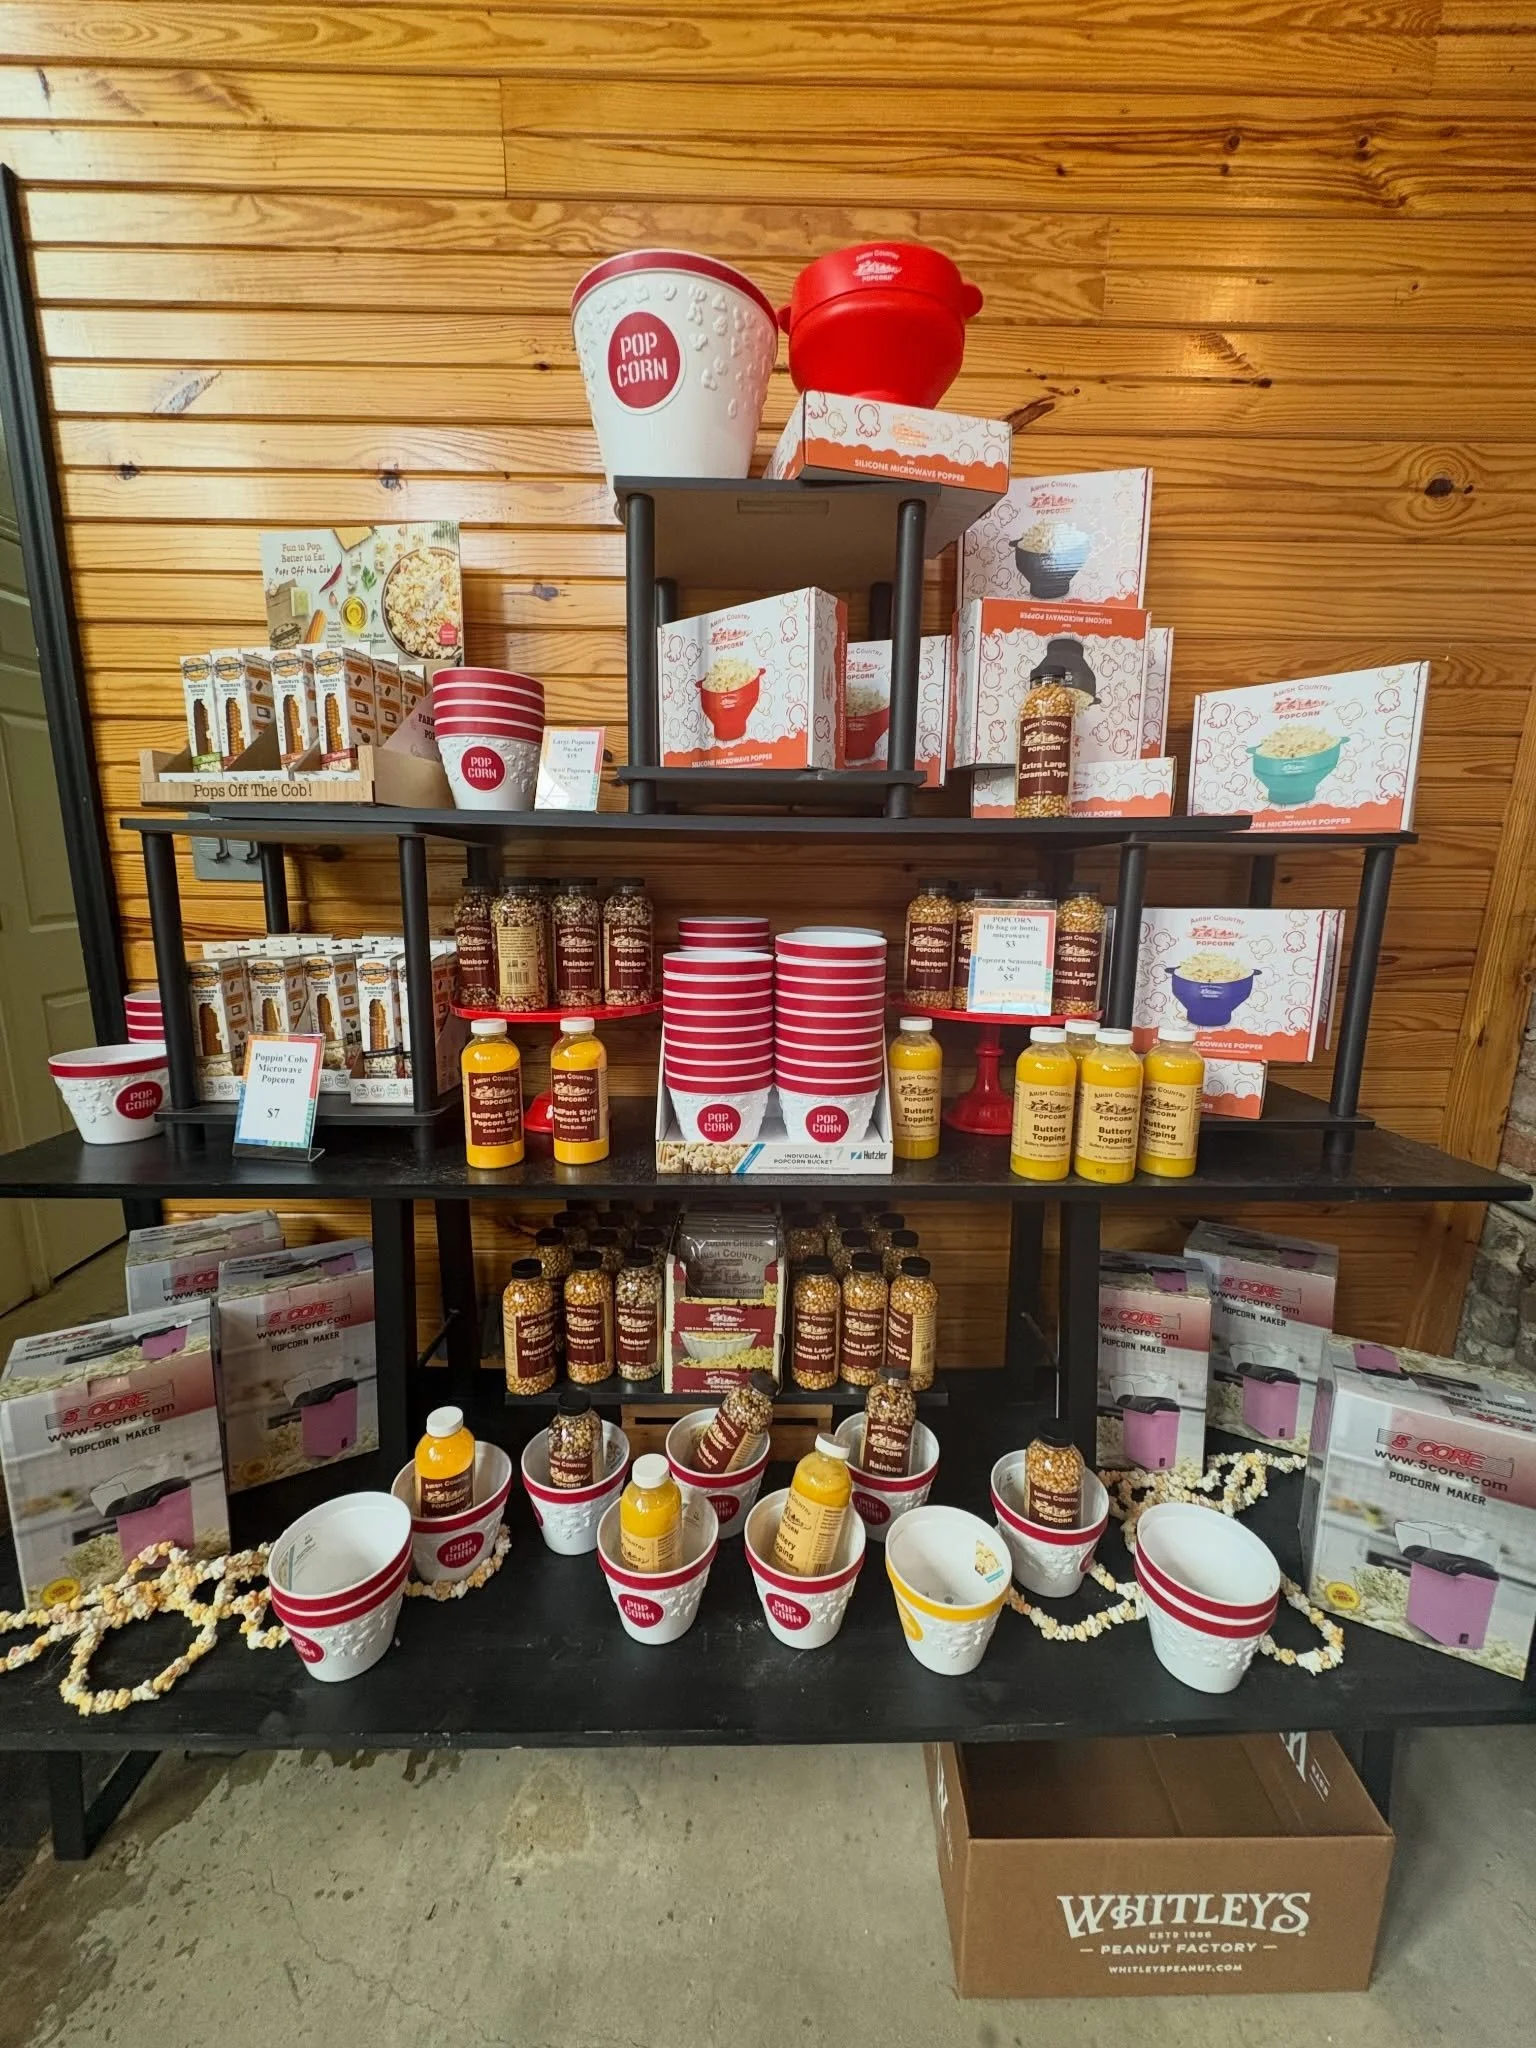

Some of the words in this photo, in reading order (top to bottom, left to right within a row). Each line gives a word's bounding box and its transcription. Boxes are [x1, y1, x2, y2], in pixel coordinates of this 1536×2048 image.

[620, 332, 658, 360] POP
[617, 358, 668, 388] CORN
[855, 459, 889, 471] SILICONE
[889, 463, 936, 477] MICROWAVE
[937, 470, 965, 482] POPPER
[282, 543, 296, 552] Fun
[281, 554, 303, 563] Better
[313, 553, 325, 561] Eat
[274, 567, 289, 576] Pops
[291, 566, 305, 576] Off
[1045, 614, 1084, 624] MICROWAVE
[1085, 616, 1113, 625] SILICONE
[715, 641, 744, 652] POPCORN
[856, 648, 883, 656] COUNTRY
[1273, 687, 1296, 697] AMISH
[1297, 684, 1332, 692] COUNTRY
[1278, 710, 1320, 720] POPCORN
[1023, 721, 1040, 732] AMISH
[1041, 719, 1069, 729] COUNTRY
[1028, 745, 1061, 753] POPCORN
[470, 756, 492, 767] POP
[691, 759, 715, 768] SILICONE
[716, 754, 750, 765] MICROWAVE
[750, 752, 773, 762] POPPER
[1022, 761, 1043, 770] Extra
[1044, 760, 1066, 770] Large
[467, 766, 497, 779] CORN
[1019, 770, 1050, 780] Caramel
[1052, 769, 1069, 779] Type
[194, 784, 225, 800] Pops
[228, 783, 248, 797] Off
[249, 783, 278, 797] The
[281, 783, 312, 797] Cob!
[1267, 818, 1318, 827] MICROWAVE
[1190, 916, 1212, 925] AMISH
[1213, 914, 1245, 926] COUNTRY
[1006, 940, 1016, 948] $3
[910, 959, 948, 968] Mushroom
[978, 957, 1006, 965] Popcorn
[1008, 959, 1042, 967] Seasoning
[288, 1054, 308, 1064] Cobs
[259, 1063, 303, 1074] Microwave
[262, 1074, 295, 1084] Popcorn
[473, 1077, 491, 1086] AMISH
[567, 1073, 594, 1081] COUNTRY
[130, 1089, 153, 1102] POP
[1158, 1086, 1187, 1099] COUNTRY
[125, 1098, 157, 1112] CORN
[480, 1098, 513, 1106] POPCORN
[267, 1108, 280, 1119] $7
[472, 1111, 503, 1119] BallPark
[708, 1114, 729, 1123] POP
[1145, 1108, 1177, 1118] POPCORN
[474, 1119, 506, 1128] Popcorn
[507, 1116, 519, 1124] Salt
[816, 1114, 838, 1124] POP
[903, 1115, 934, 1123] Topping
[704, 1122, 733, 1132] CORN
[813, 1123, 842, 1133] CORN
[1033, 1124, 1066, 1134] Buttery
[1098, 1126, 1132, 1136] Buttery
[1143, 1119, 1177, 1132] Buttery
[1032, 1132, 1066, 1142] Topping
[1143, 1127, 1177, 1140] Topping
[1097, 1135, 1133, 1145] Topping
[863, 1151, 888, 1160] Hutzler
[723, 1249, 763, 1264] COUNTRY
[193, 1268, 218, 1286] CO
[1222, 1276, 1234, 1288] 5
[1238, 1279, 1283, 1299] CORE
[1211, 1289, 1300, 1316] www.5core.com
[268, 1311, 281, 1325] 5
[287, 1301, 334, 1320] CORE
[1118, 1308, 1164, 1327] CORE
[1221, 1306, 1256, 1320] POPCORN
[1260, 1315, 1287, 1328] MAKER
[257, 1314, 351, 1340] www.5core.com
[271, 1340, 309, 1353] POPCORN
[312, 1330, 340, 1344] MAKER
[620, 1336, 650, 1344] Rainbow
[844, 1338, 861, 1348] Extra
[814, 1346, 833, 1354] Large
[1101, 1338, 1136, 1350] POPCORN
[1140, 1344, 1166, 1355] MAKER
[821, 1352, 834, 1360] Type
[868, 1348, 882, 1357] Type
[895, 1352, 910, 1361] Type
[63, 1406, 80, 1426] 5
[87, 1390, 152, 1420] CORE
[48, 1403, 175, 1443] www.5core.com
[887, 1425, 909, 1437] COUNTRY
[69, 1437, 120, 1456] POPCORN
[126, 1424, 161, 1441] MAKER
[873, 1446, 902, 1457] POPCORN
[1391, 1434, 1414, 1450] 5
[1416, 1439, 1488, 1471] CORE
[562, 1461, 587, 1469] COUNTRY
[869, 1459, 904, 1474] Rainbow
[1374, 1449, 1508, 1492] www.5core.com
[1389, 1471, 1441, 1493] POPCORN
[1446, 1487, 1487, 1506] MAKER
[1038, 1512, 1072, 1524] POPCORN
[450, 1540, 472, 1553] POP
[445, 1545, 477, 1562] CORN
[626, 1600, 649, 1612] POP
[774, 1600, 796, 1614] POP
[624, 1607, 655, 1621] CORN
[772, 1606, 802, 1624] CORN
[1057, 1892, 1312, 1938] WHITLEY'S
[1149, 1931, 1179, 1939] ESTD
[1101, 1943, 1171, 1954] PEANUT
[1176, 1942, 1257, 1953] FACTORY
[1109, 1964, 1242, 1974] WHITLEYSPEANUT.COM
